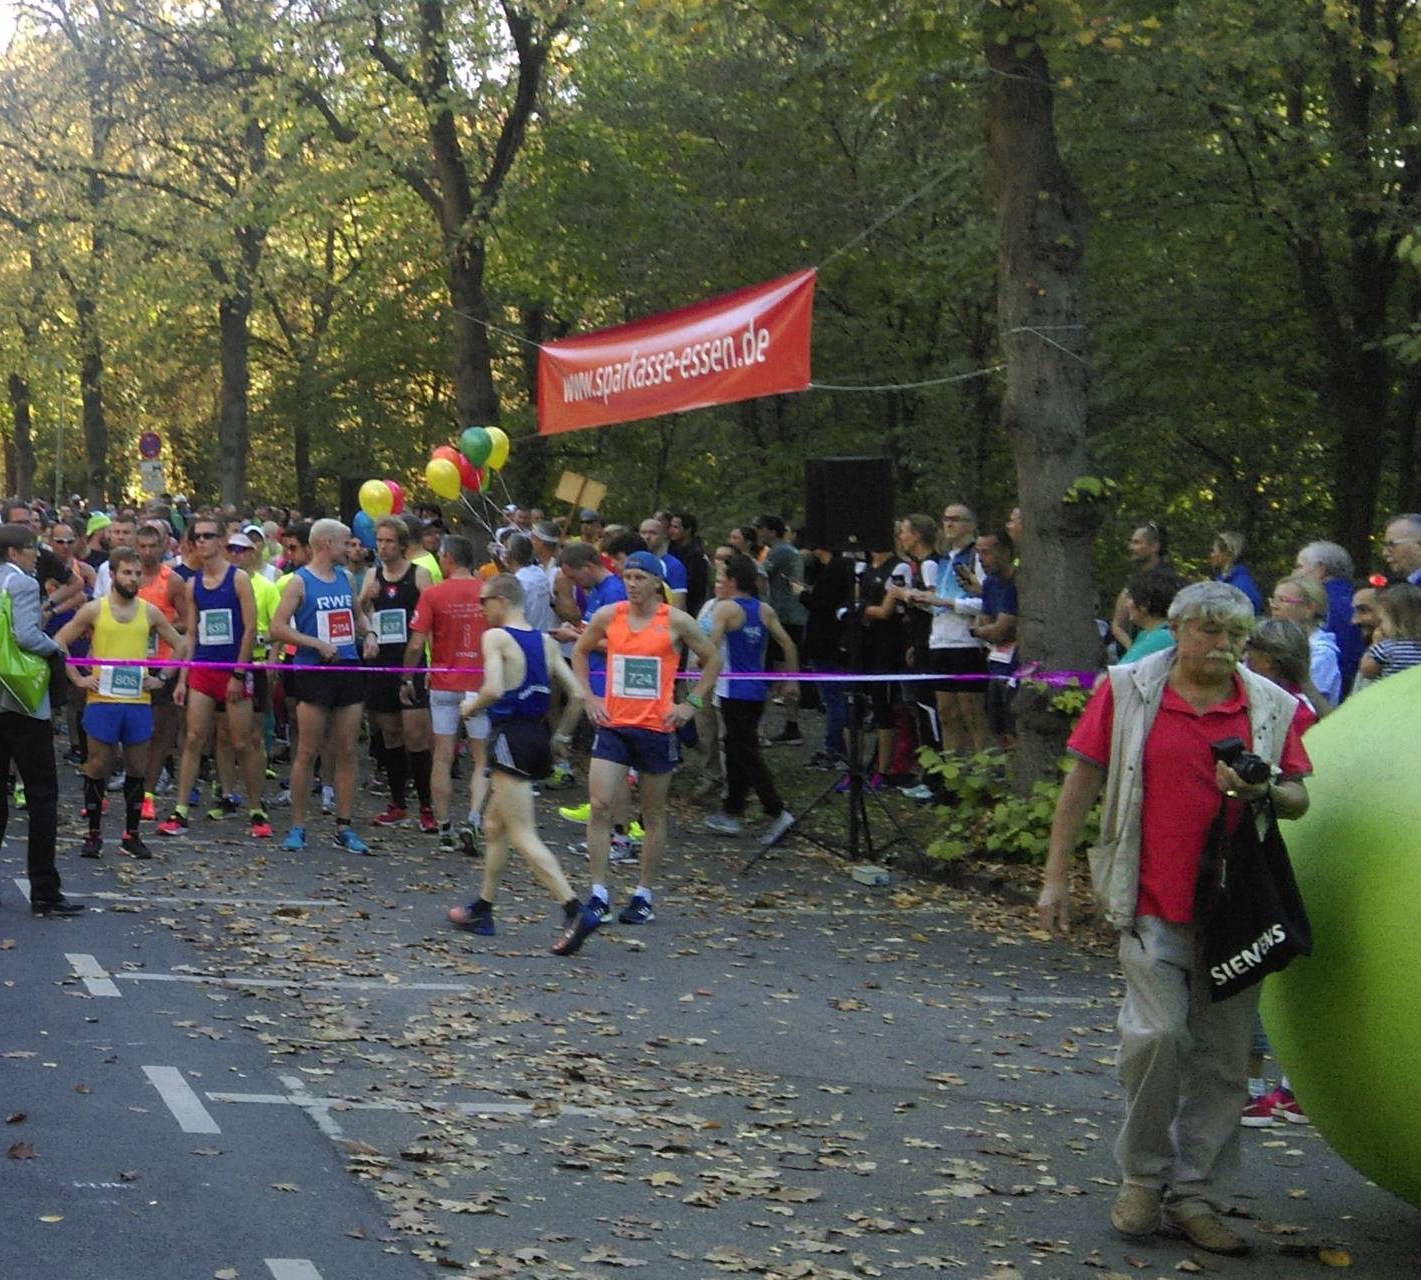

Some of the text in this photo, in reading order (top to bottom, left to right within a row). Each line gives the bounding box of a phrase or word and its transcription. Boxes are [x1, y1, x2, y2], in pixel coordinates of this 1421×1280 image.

[562, 318, 770, 405] www.sparkasse-essen.de
[317, 595, 353, 610] RWE
[628, 673, 653, 686] 724
